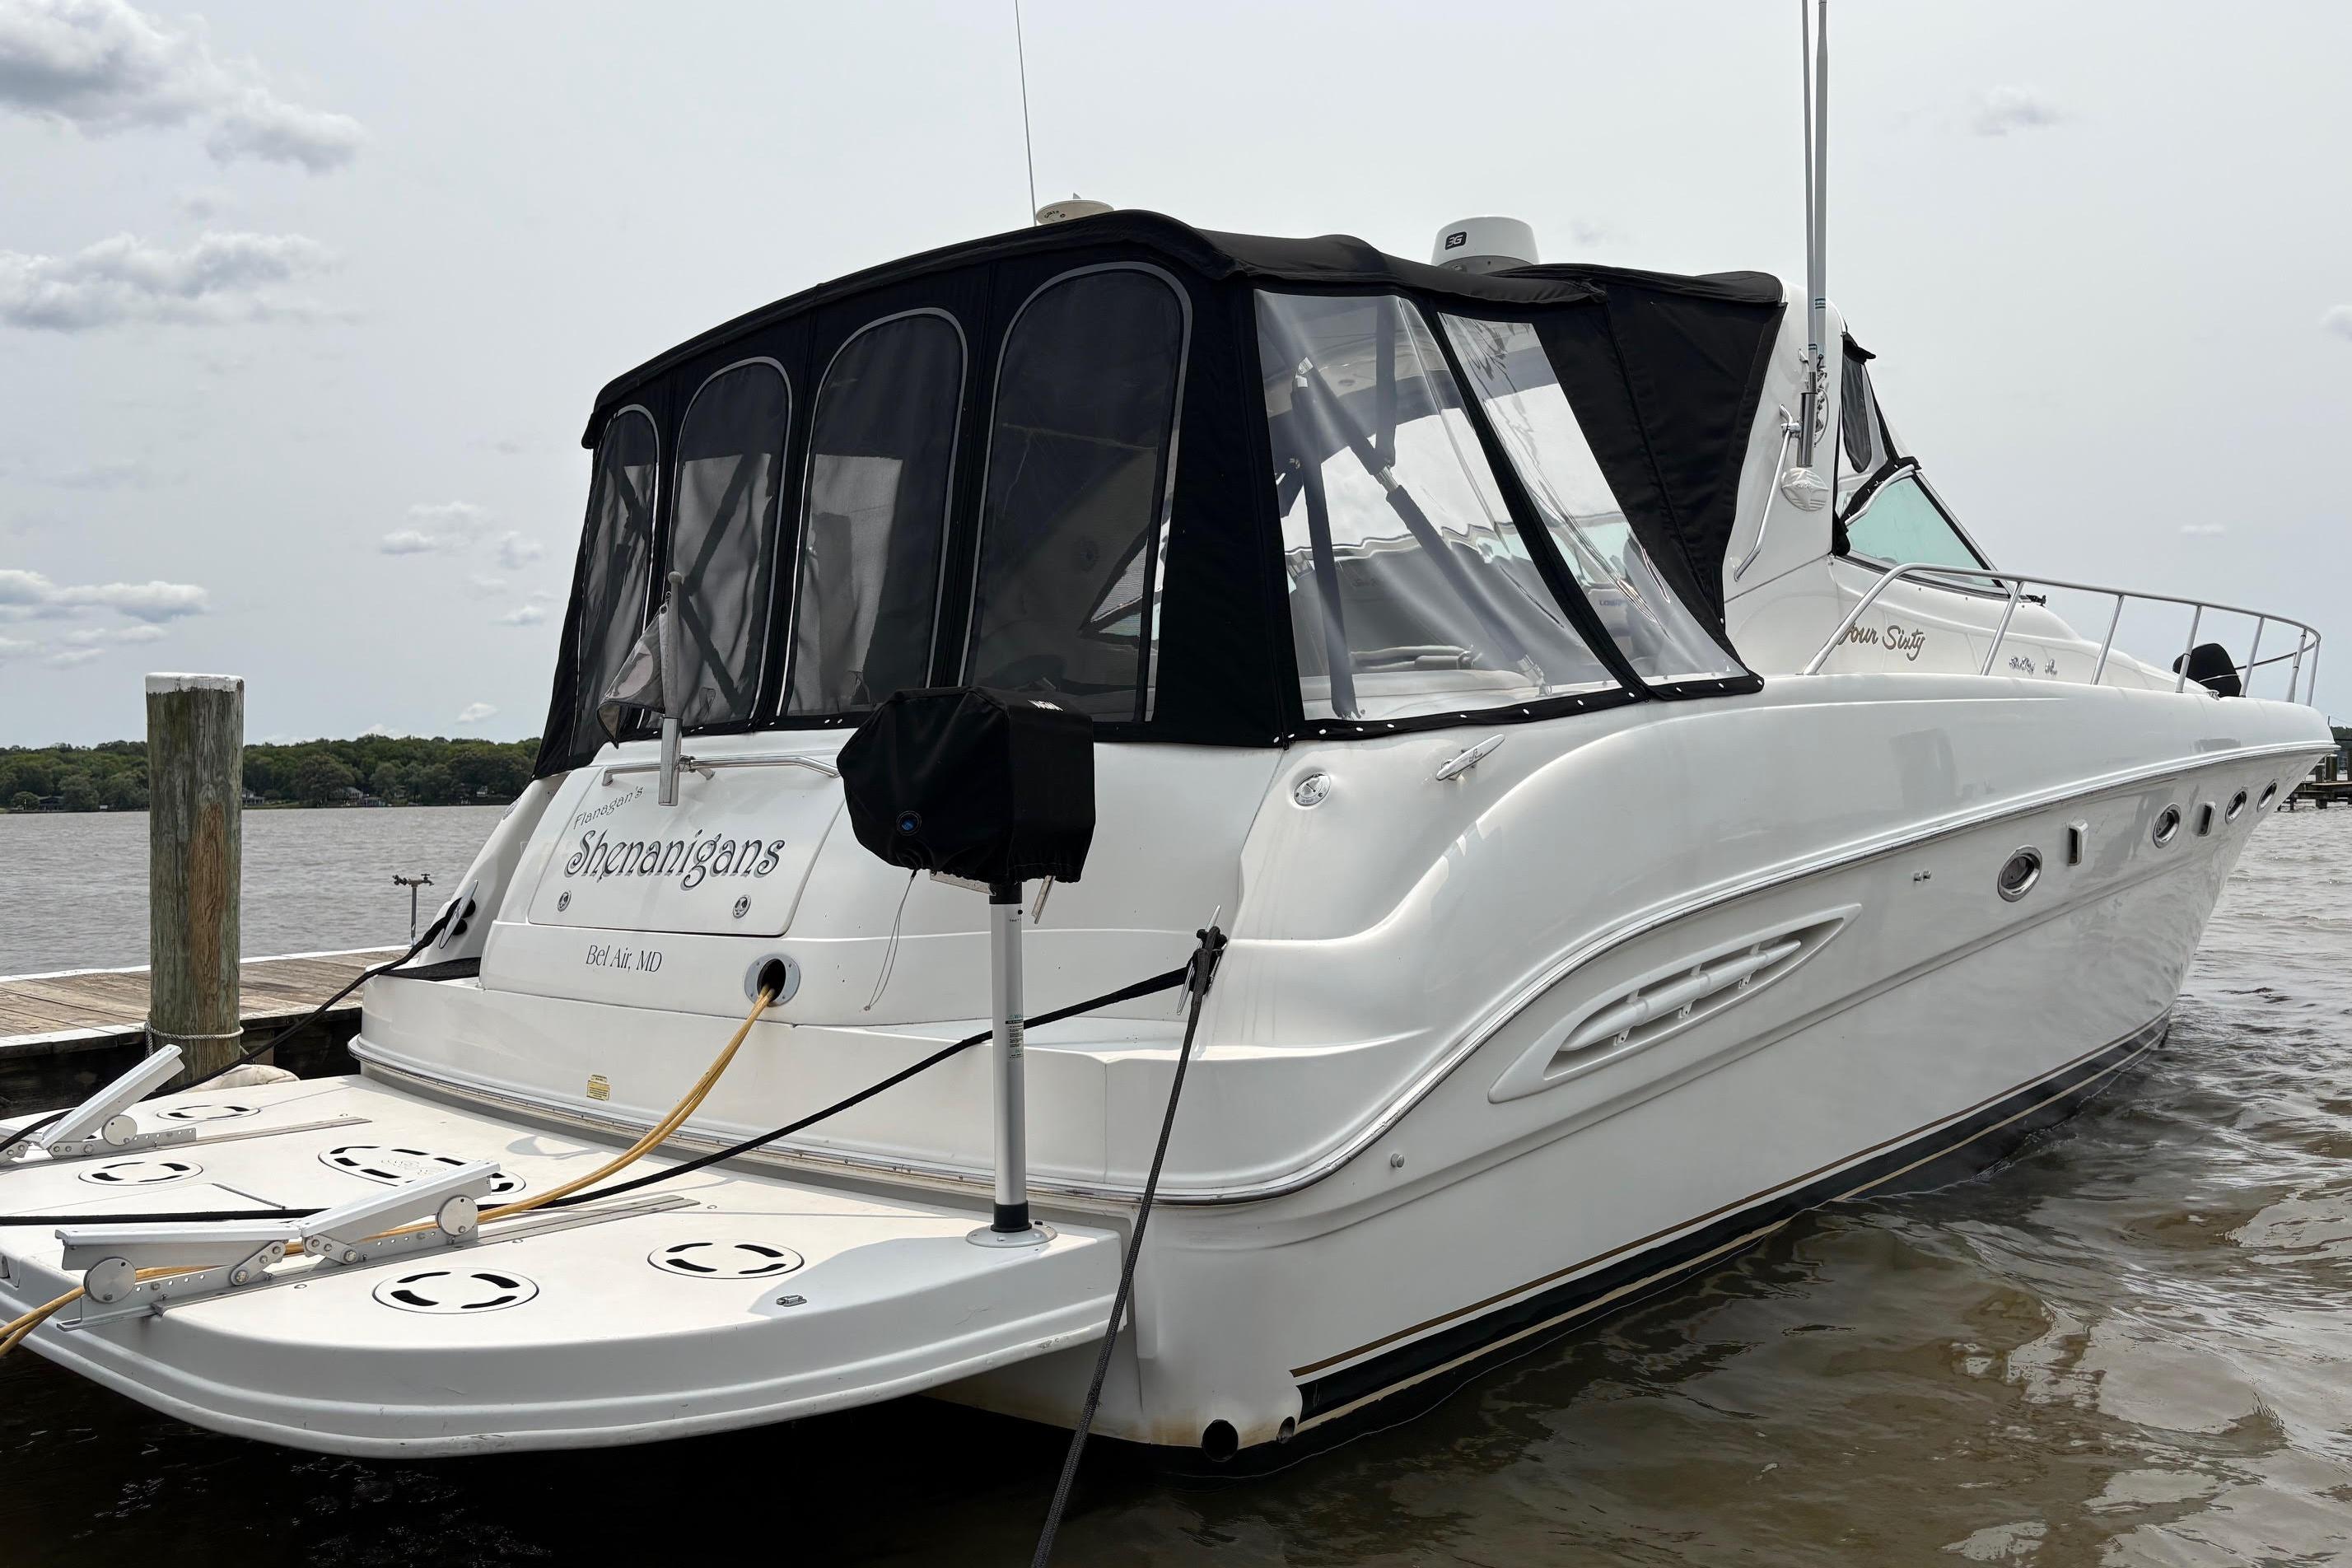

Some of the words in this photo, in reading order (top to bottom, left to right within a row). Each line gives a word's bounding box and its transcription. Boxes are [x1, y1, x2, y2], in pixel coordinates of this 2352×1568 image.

[1447, 235, 1463, 247] 3G
[1882, 624, 1925, 661] Sixty
[573, 786, 644, 830] Flanagan's
[564, 828, 786, 891] Shenanigans
[586, 945, 610, 966] Bel
[609, 947, 632, 973] Air,
[636, 950, 662, 973] MD
